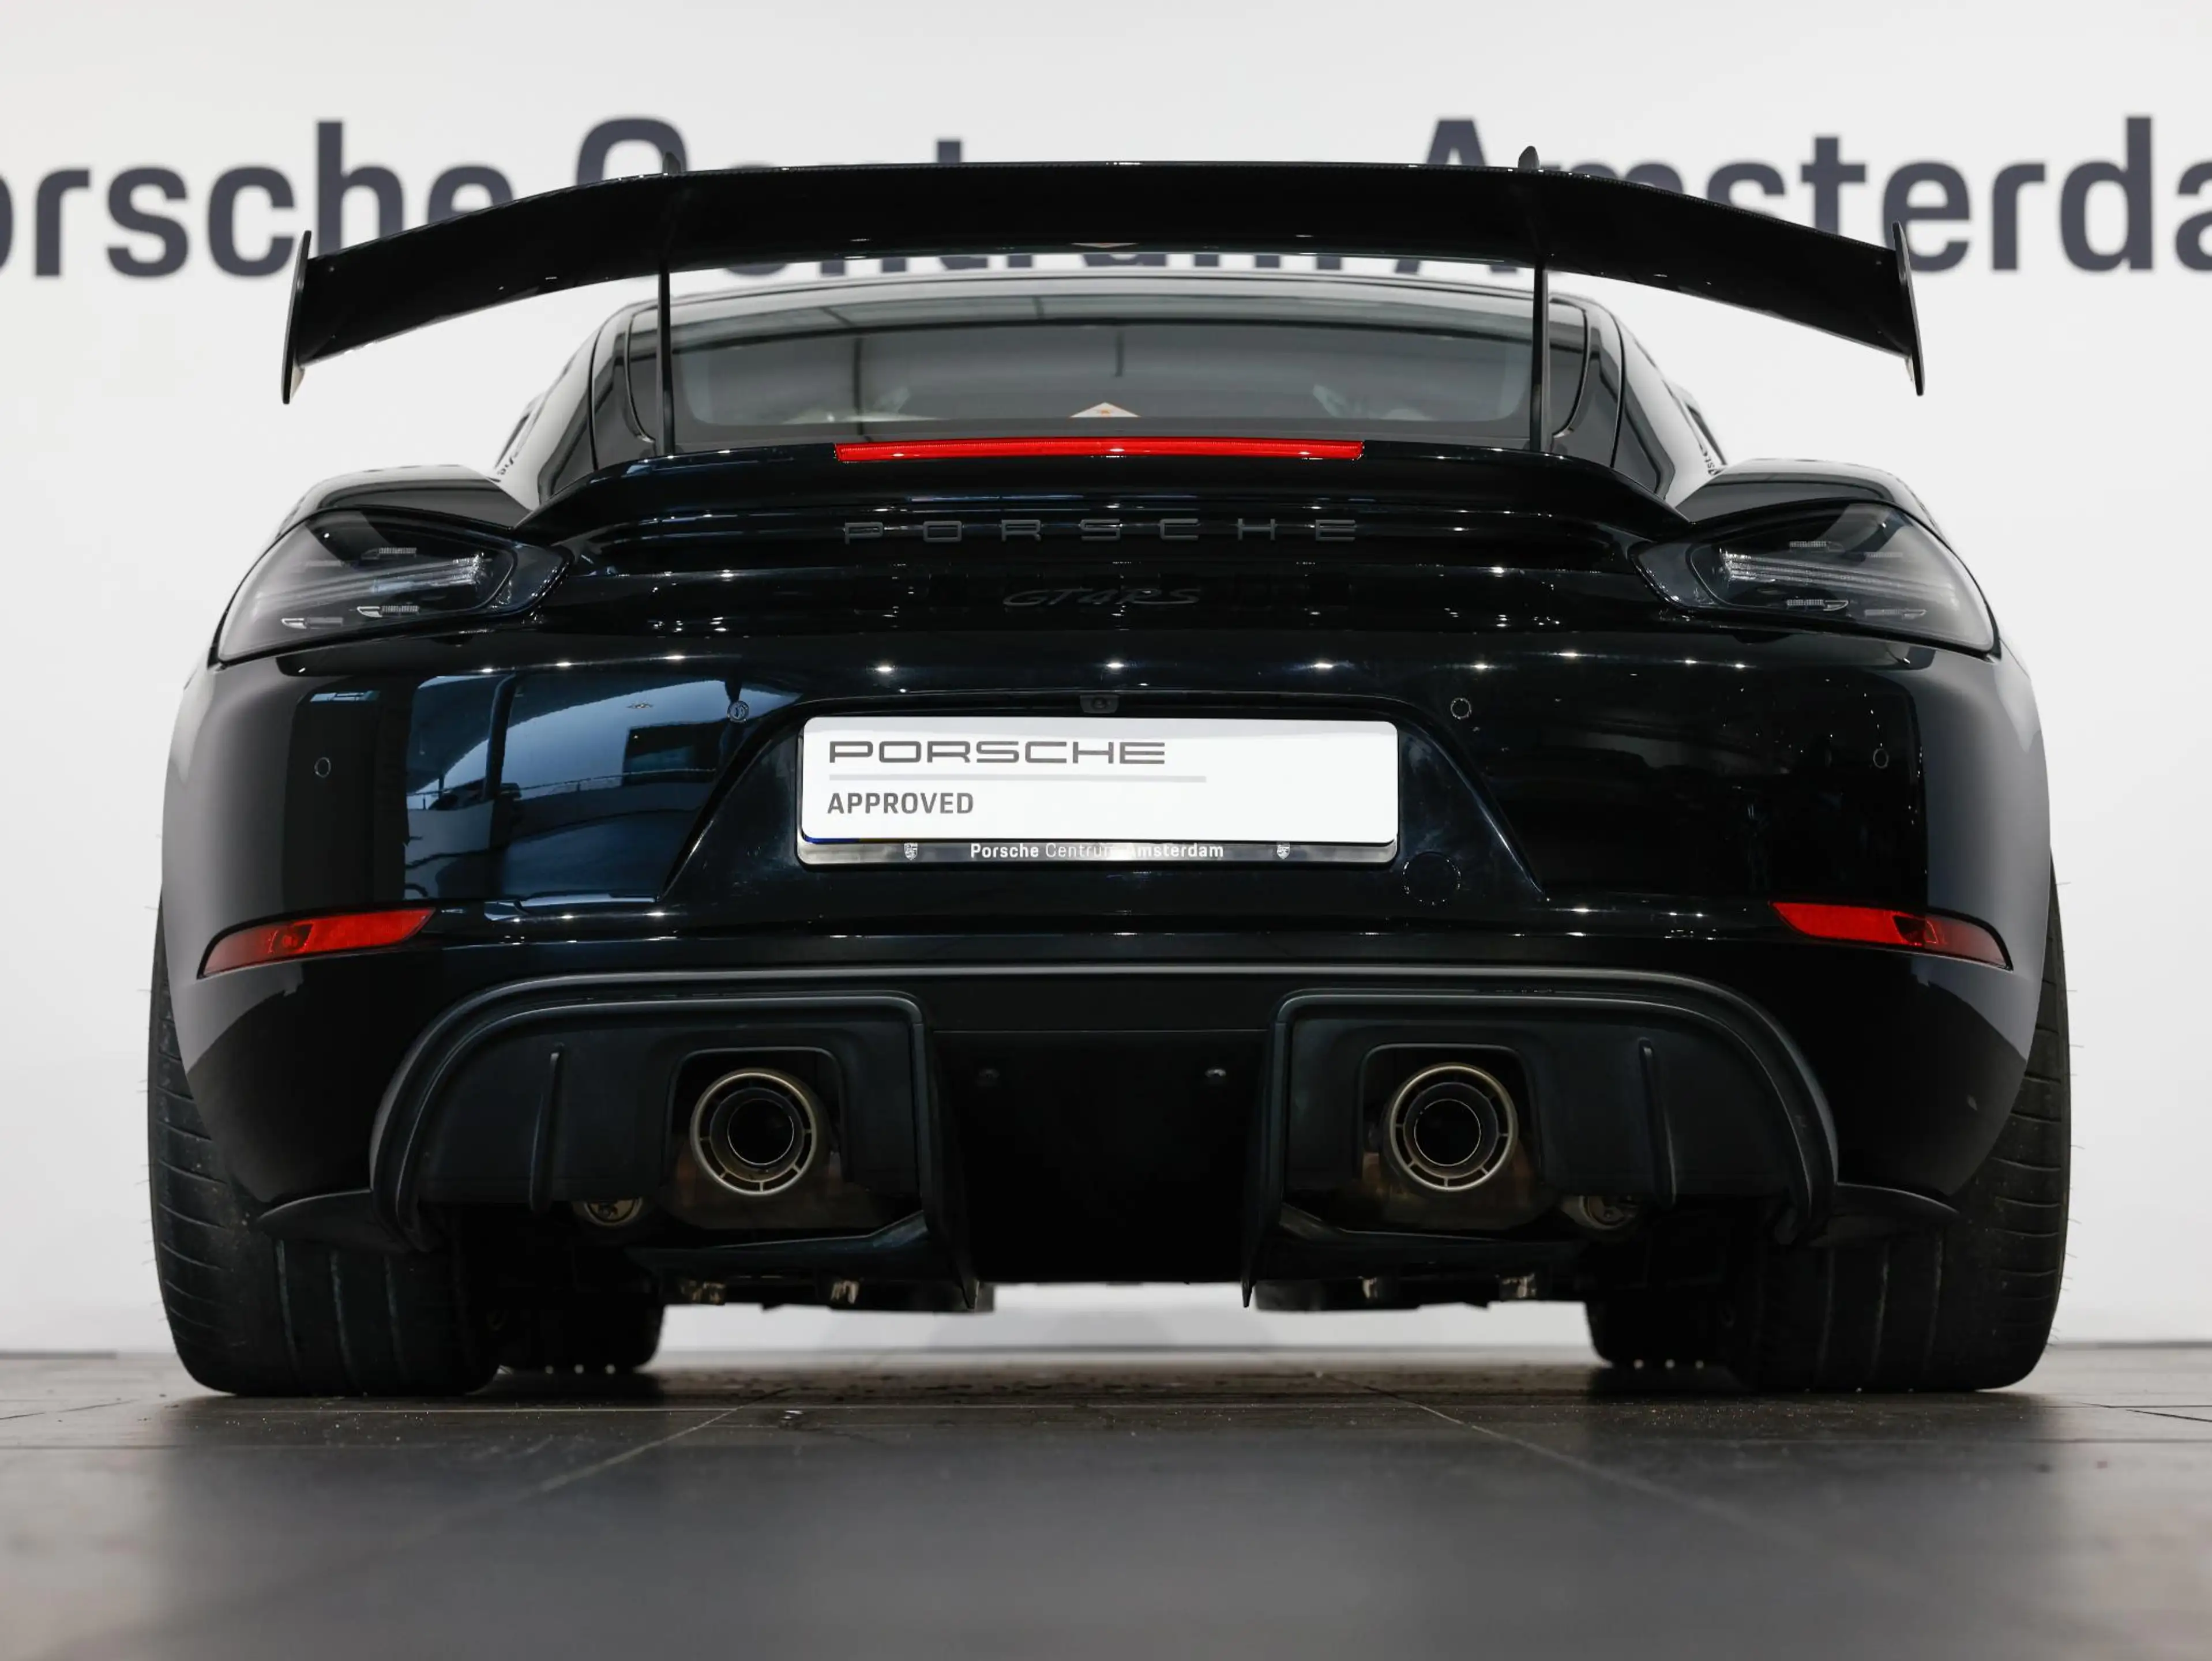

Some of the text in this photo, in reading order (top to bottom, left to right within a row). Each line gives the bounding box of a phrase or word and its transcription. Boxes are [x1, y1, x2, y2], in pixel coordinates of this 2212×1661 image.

[844, 518, 1357, 544] PORSCHE
[829, 740, 1165, 765] PORSCHE
[827, 792, 974, 814] APPROVED
[971, 843, 1039, 858] Porsche
